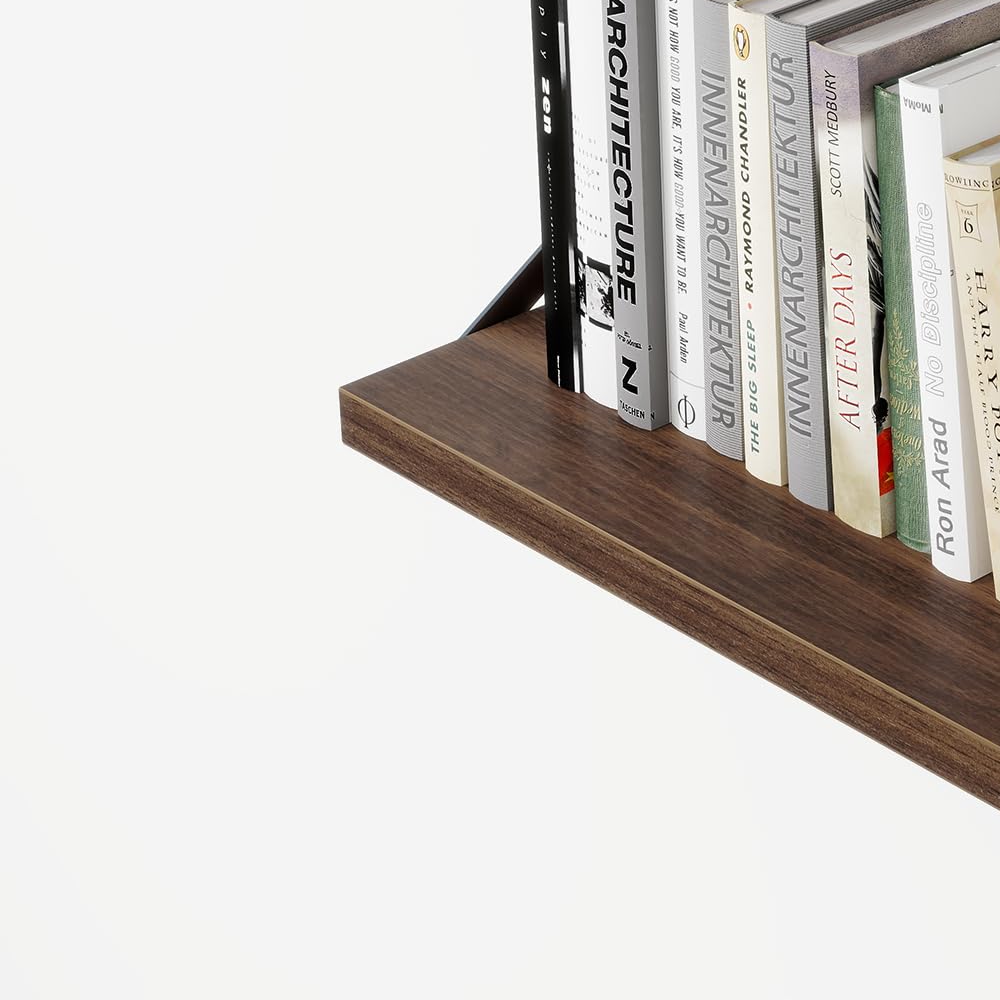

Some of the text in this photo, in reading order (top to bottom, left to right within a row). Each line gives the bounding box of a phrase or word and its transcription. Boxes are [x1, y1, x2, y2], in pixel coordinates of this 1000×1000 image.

[668, 6, 679, 28] NOT
[669, 30, 680, 54] HOW
[670, 56, 680, 83] GOOD
[542, 77, 552, 134] zen
[671, 86, 681, 107] YOU
[903, 96, 932, 114] MoMA
[673, 135, 683, 155] IT'S
[824, 69, 842, 198] SCOTT MEDBURY
[674, 157, 684, 181] HOW
[675, 212, 686, 232] YOU
[964, 217, 974, 234] 6
[675, 235, 687, 263] WANT
[701, 69, 735, 429] INNENARCHITEKTUR
[771, 51, 812, 438] INNENARCHITEKTUR
[677, 265, 687, 278] TO
[737, 76, 760, 454] THE BIG SLEEP RAYMOND CHANDLER
[678, 312, 689, 364] Paul Arden
[830, 248, 861, 431] AFTER DAYS
[974, 267, 999, 392] HARRY
[916, 202, 955, 557] Ron Arad No Discipline
[619, 399, 645, 419] TASCHEN
[988, 456, 1000, 513] PRINCE
